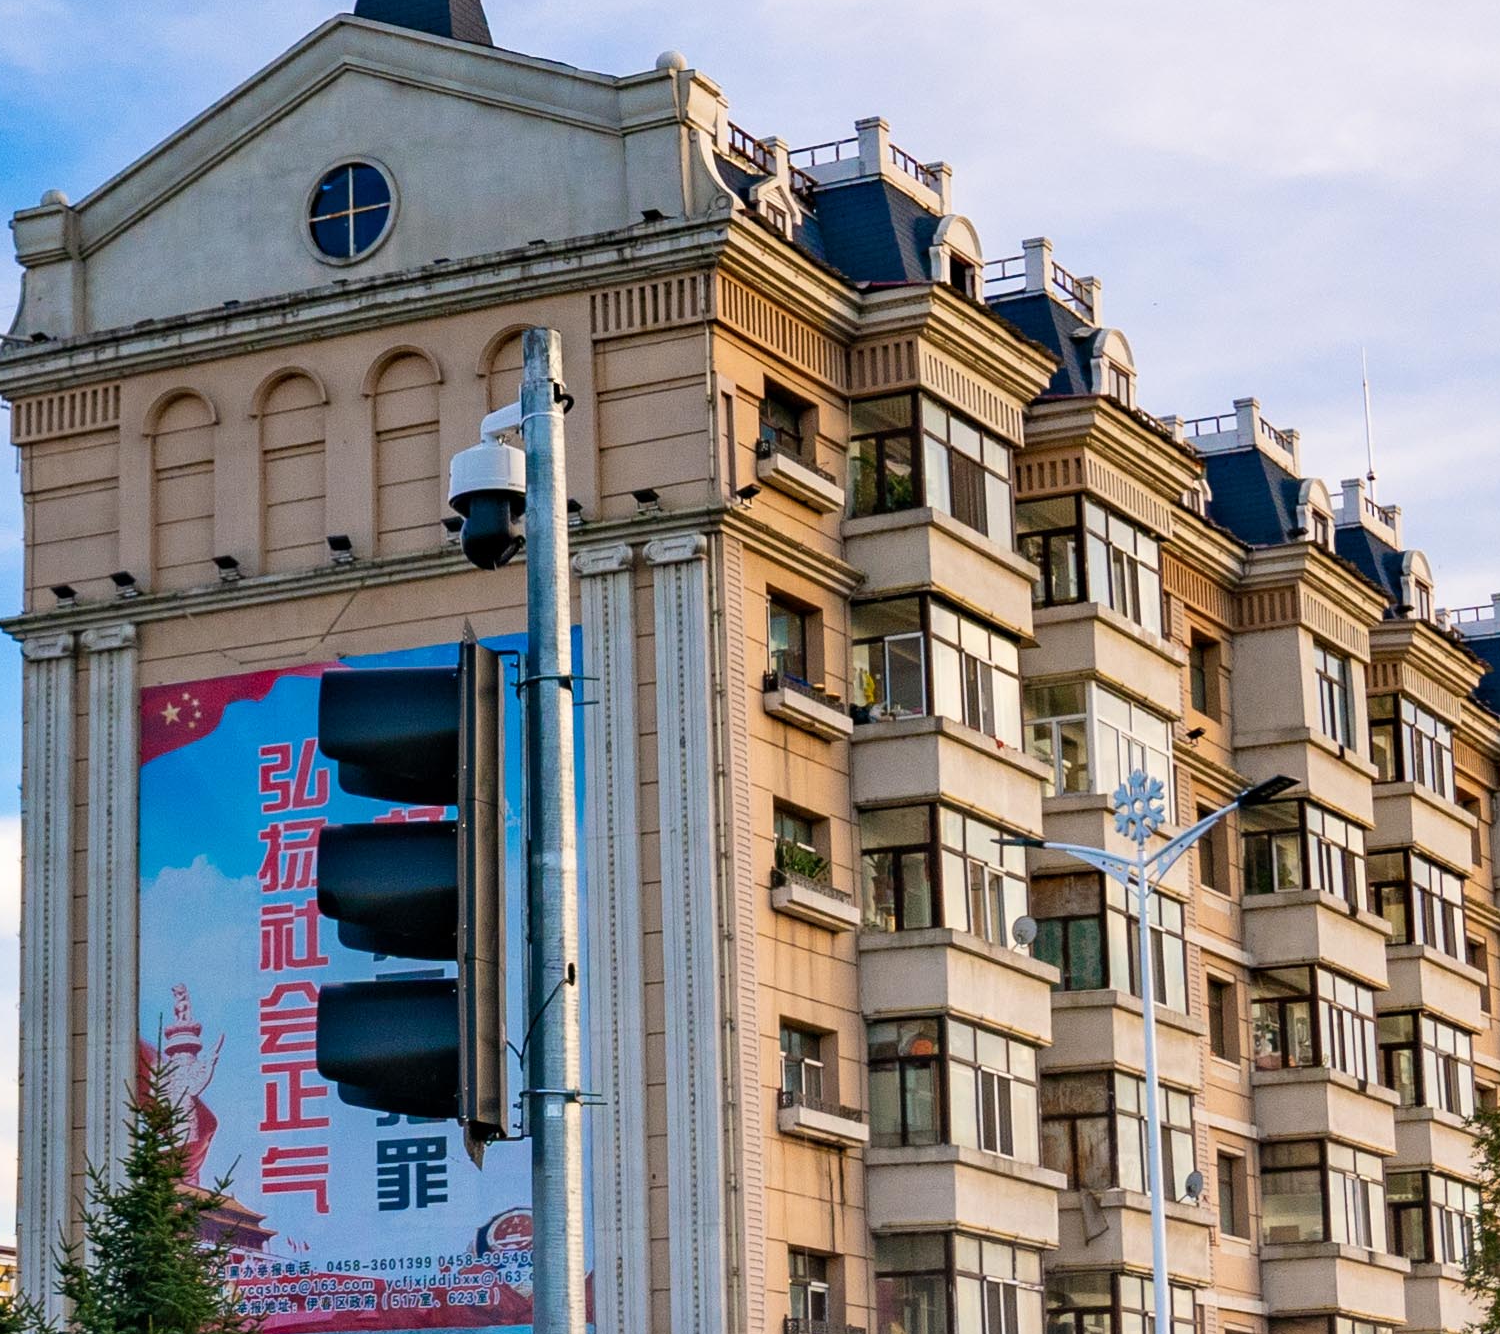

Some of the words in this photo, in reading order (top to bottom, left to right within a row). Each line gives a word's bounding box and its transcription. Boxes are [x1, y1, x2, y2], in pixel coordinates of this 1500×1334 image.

[258, 742, 329, 1214] 弘扬社会正气
[327, 1256, 433, 1273] 0458-3601399
[240, 1278, 376, 1298] ycqshce@163.com
[385, 1269, 534, 1293] ycfjxjddjbxx@163.c
